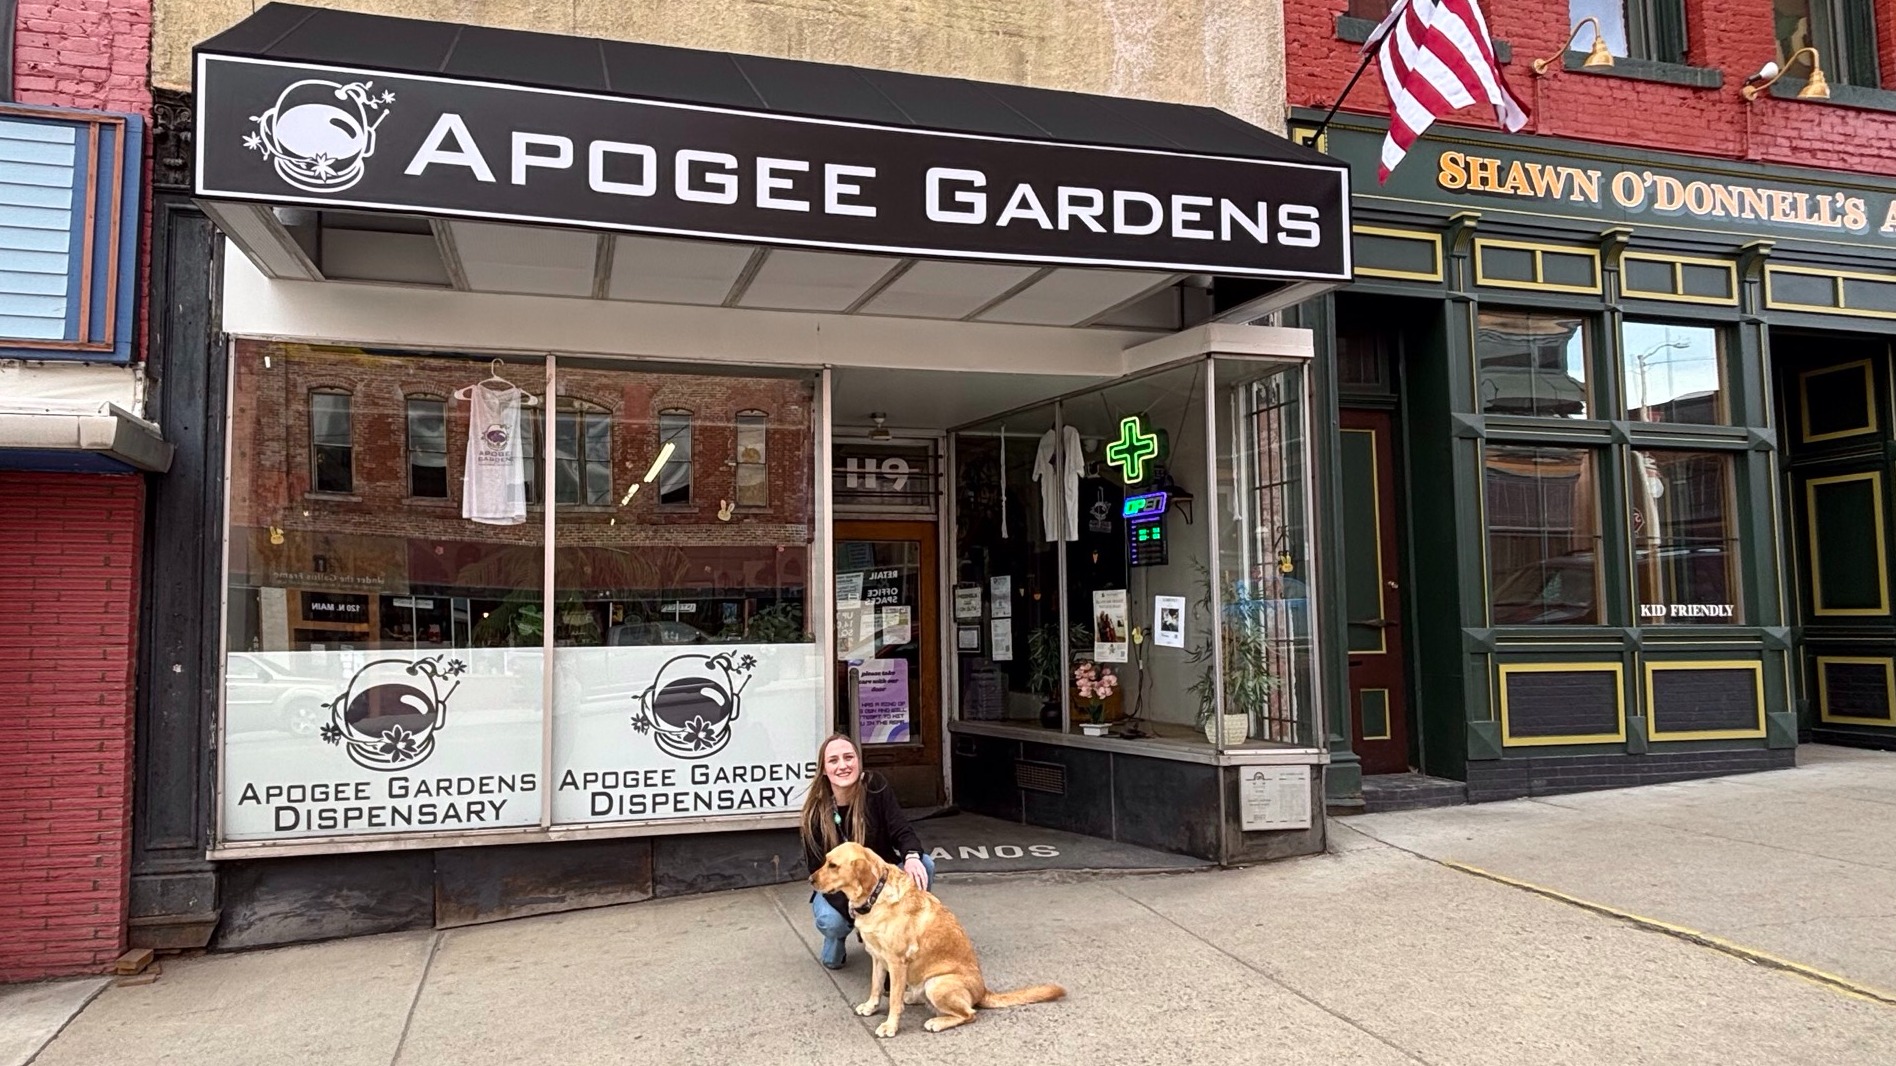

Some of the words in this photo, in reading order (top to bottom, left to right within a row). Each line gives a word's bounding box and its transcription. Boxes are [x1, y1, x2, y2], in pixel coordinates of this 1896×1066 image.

[404, 113, 877, 217] APOGEE
[925, 167, 1321, 248] GARDENS
[1438, 151, 1602, 203] SHAWN
[1611, 170, 1867, 233] O'DONNELL'S
[846, 457, 910, 491] 119
[1125, 497, 1163, 515] OPEN
[1640, 604, 1666, 617] KID
[1670, 604, 1734, 617] FRIENDLY
[238, 782, 371, 806] APOGEE
[388, 773, 537, 800] GARDENS
[558, 768, 675, 791] APOGEE
[690, 761, 818, 785] GARDENS
[274, 799, 508, 832] DISPENSARY
[590, 785, 794, 816] DISPENSARY
[930, 844, 1060, 860] ANOS
